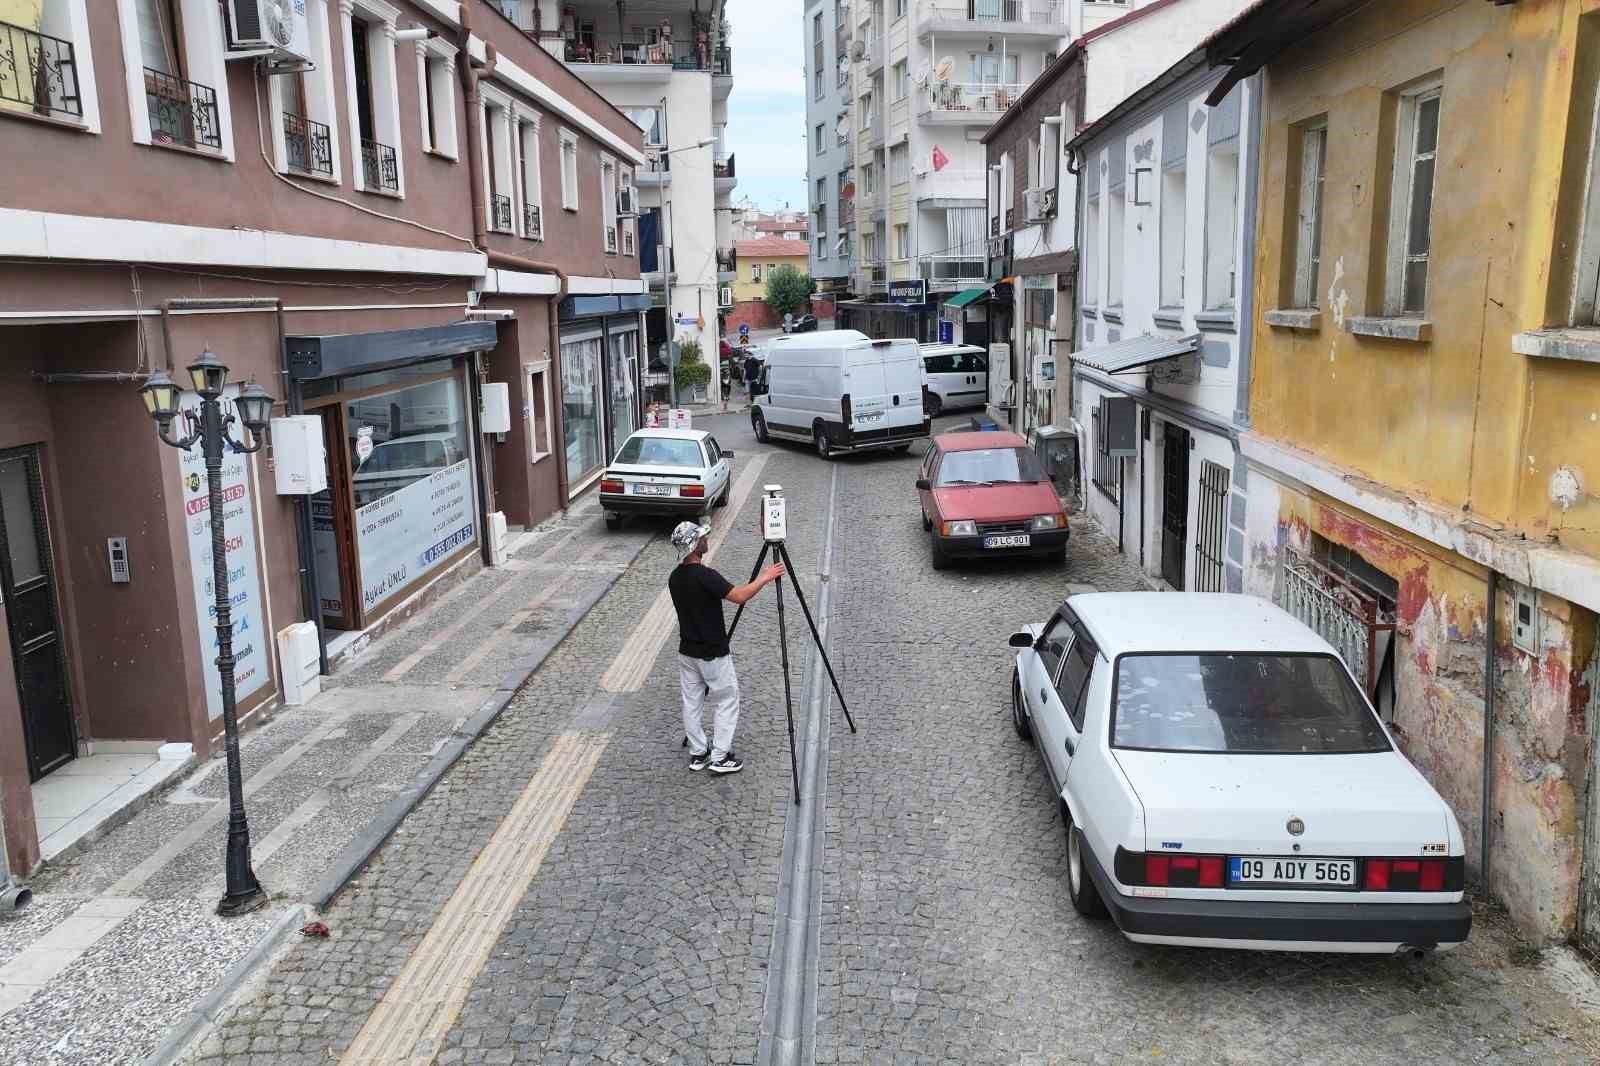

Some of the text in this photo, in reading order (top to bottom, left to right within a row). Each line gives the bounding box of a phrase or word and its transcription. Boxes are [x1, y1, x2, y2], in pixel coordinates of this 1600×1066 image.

[364, 563, 408, 606] Aykut ÜNLÜ
[1241, 861, 1352, 882] 09 ADY 566
